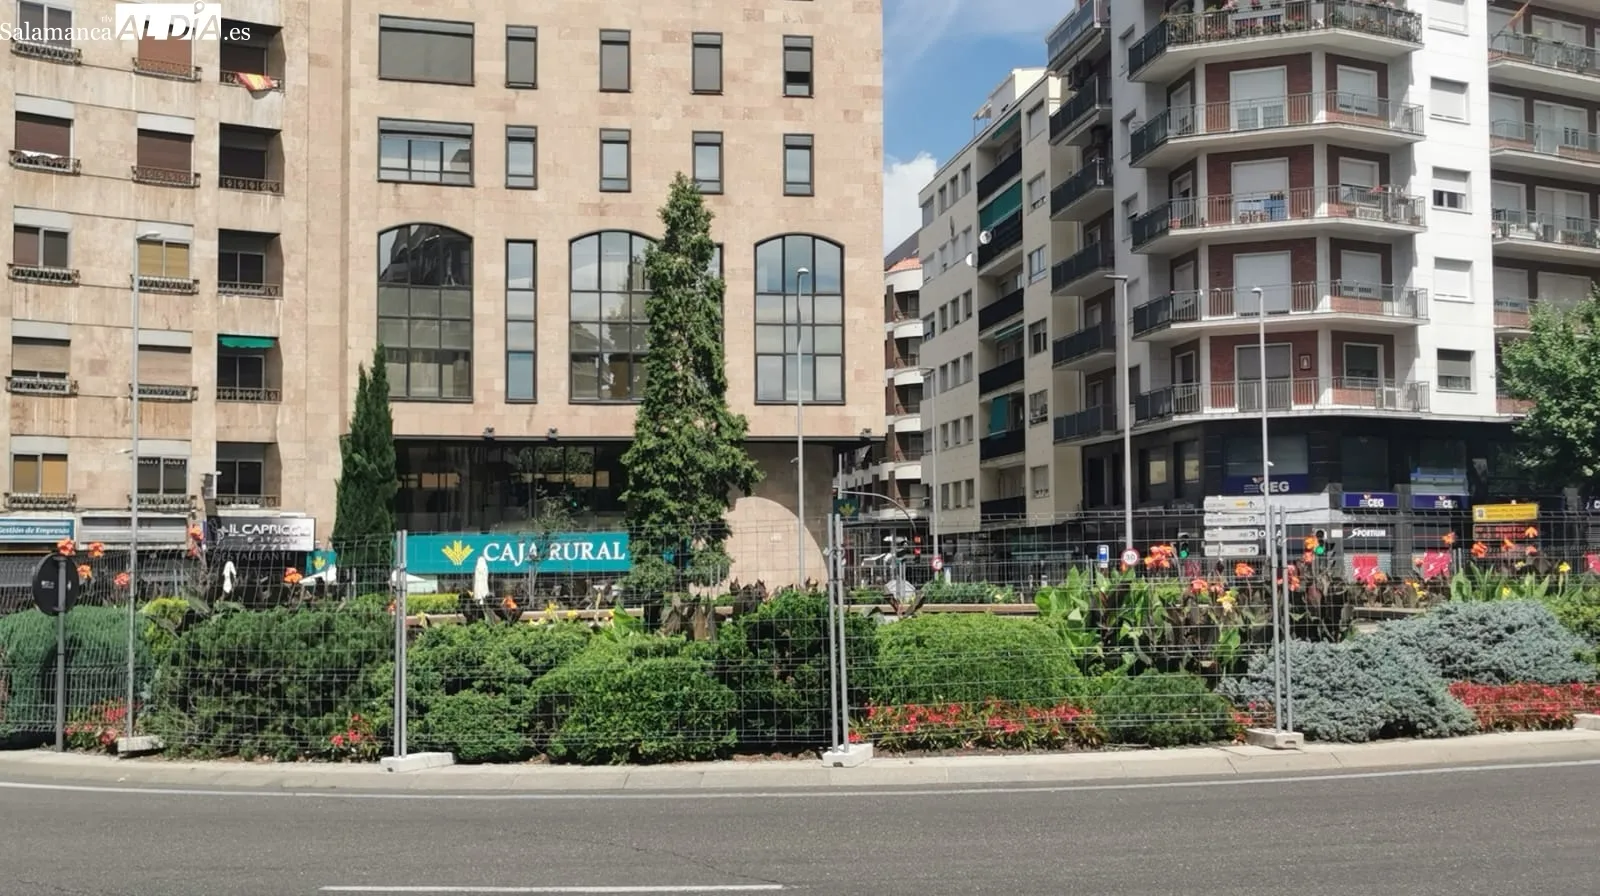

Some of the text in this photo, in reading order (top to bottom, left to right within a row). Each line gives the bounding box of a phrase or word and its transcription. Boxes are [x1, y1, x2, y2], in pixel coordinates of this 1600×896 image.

[1367, 498, 1385, 508] CEG
[484, 541, 626, 566] CAJA RURAL
